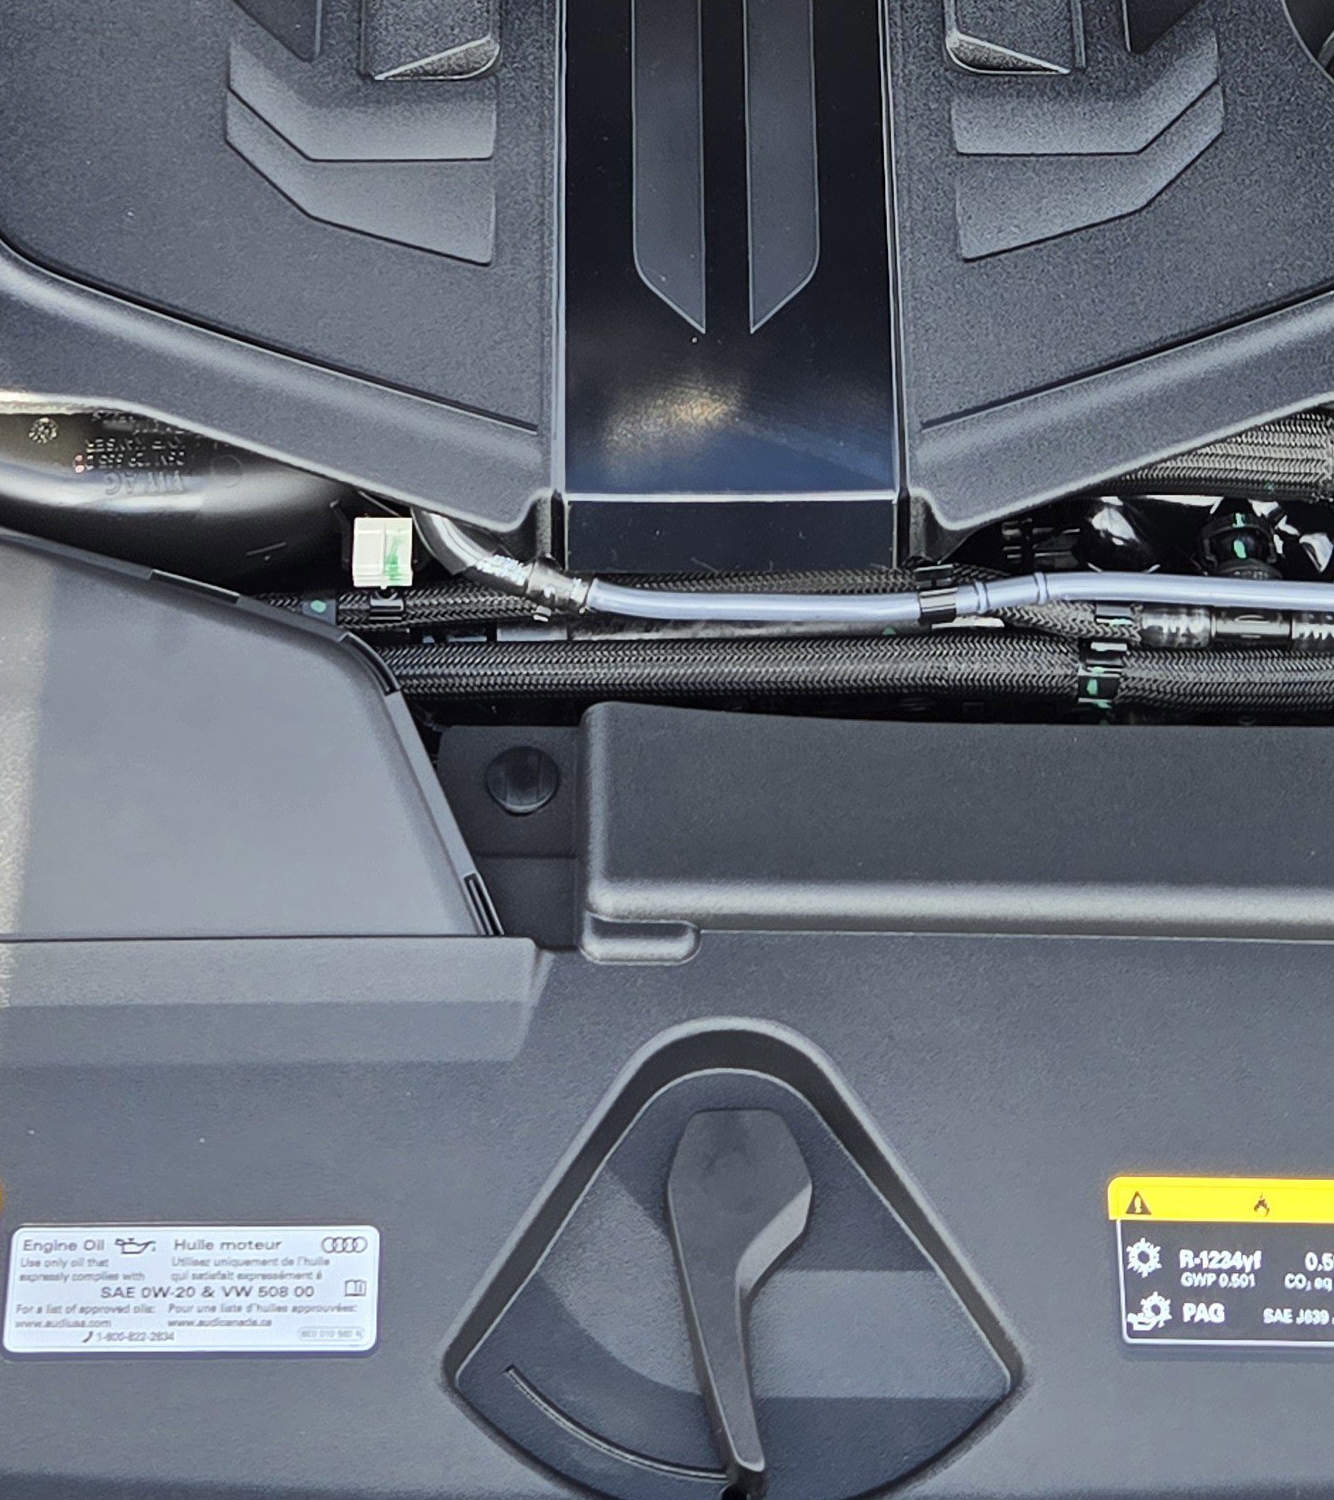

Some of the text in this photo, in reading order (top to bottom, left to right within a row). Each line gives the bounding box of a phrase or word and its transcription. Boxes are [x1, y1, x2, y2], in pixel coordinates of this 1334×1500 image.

[23, 1239, 105, 1254] Engine Oil
[174, 1239, 282, 1250] Huile moteur
[20, 1257, 109, 1268] Use only oil that
[214, 1257, 279, 1268] uniquement
[281, 1257, 295, 1266] de
[1179, 1249, 1262, 1273] R-1234yf
[72, 1272, 119, 1282] complies
[122, 1271, 145, 1281] with
[171, 1270, 188, 1281] qui
[1180, 1271, 1217, 1287] GWP
[1314, 1277, 1332, 1292] eq
[101, 1286, 315, 1298] SAE 0W-20 & VW 508 00
[16, 1303, 34, 1314] For
[37, 1305, 43, 1314] a
[47, 1303, 62, 1314] list
[65, 1303, 77, 1314] of
[79, 1304, 130, 1315] approved
[168, 1303, 194, 1313] Pour
[197, 1305, 217, 1313] une
[220, 1303, 242, 1313] liste
[1182, 1302, 1226, 1323] PAG
[1263, 1307, 1294, 1324] SAE
